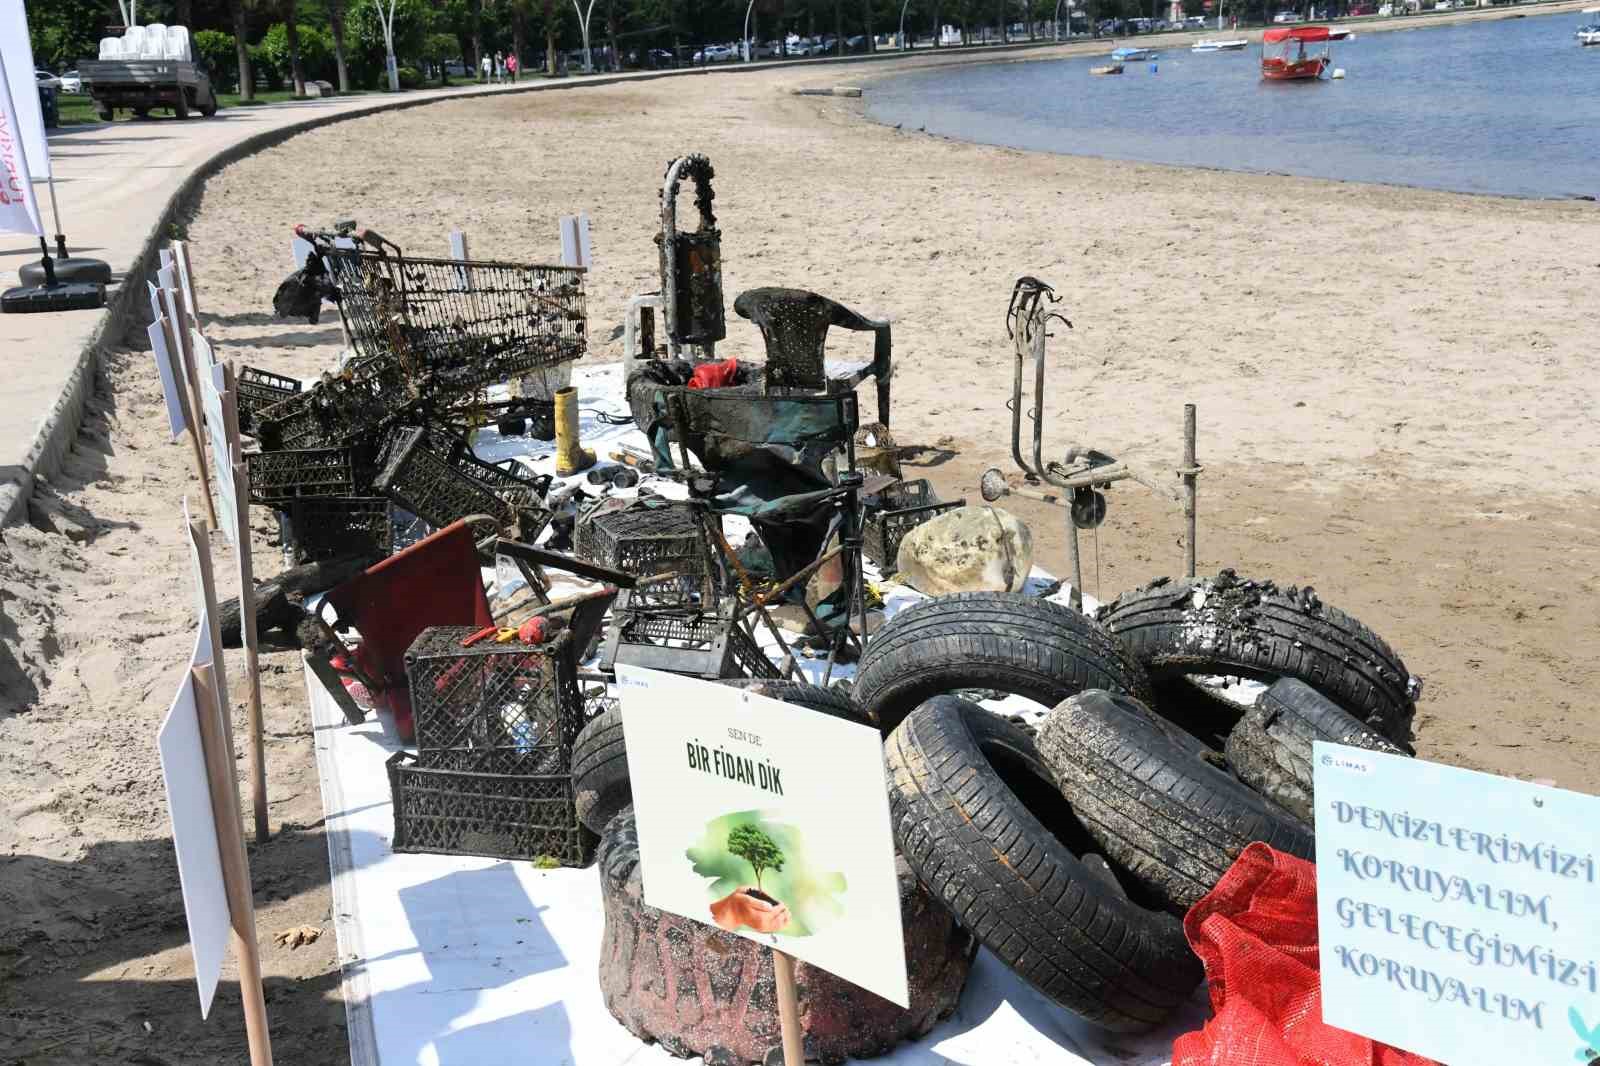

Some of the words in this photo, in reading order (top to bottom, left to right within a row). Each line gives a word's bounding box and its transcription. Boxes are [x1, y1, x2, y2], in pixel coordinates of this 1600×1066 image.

[687, 738, 712, 774] BİR
[713, 744, 756, 787] FİDAN
[758, 758, 784, 796] DİK
[727, 728, 747, 742] SEN
[748, 733, 763, 746] DE
[1330, 800, 1593, 882] DENİZLERİMİZİ
[1336, 848, 1558, 931] KORUYALIM,
[1336, 897, 1597, 993] GELECEĞİMİZİ
[1334, 945, 1546, 1030] KORUYALIM
